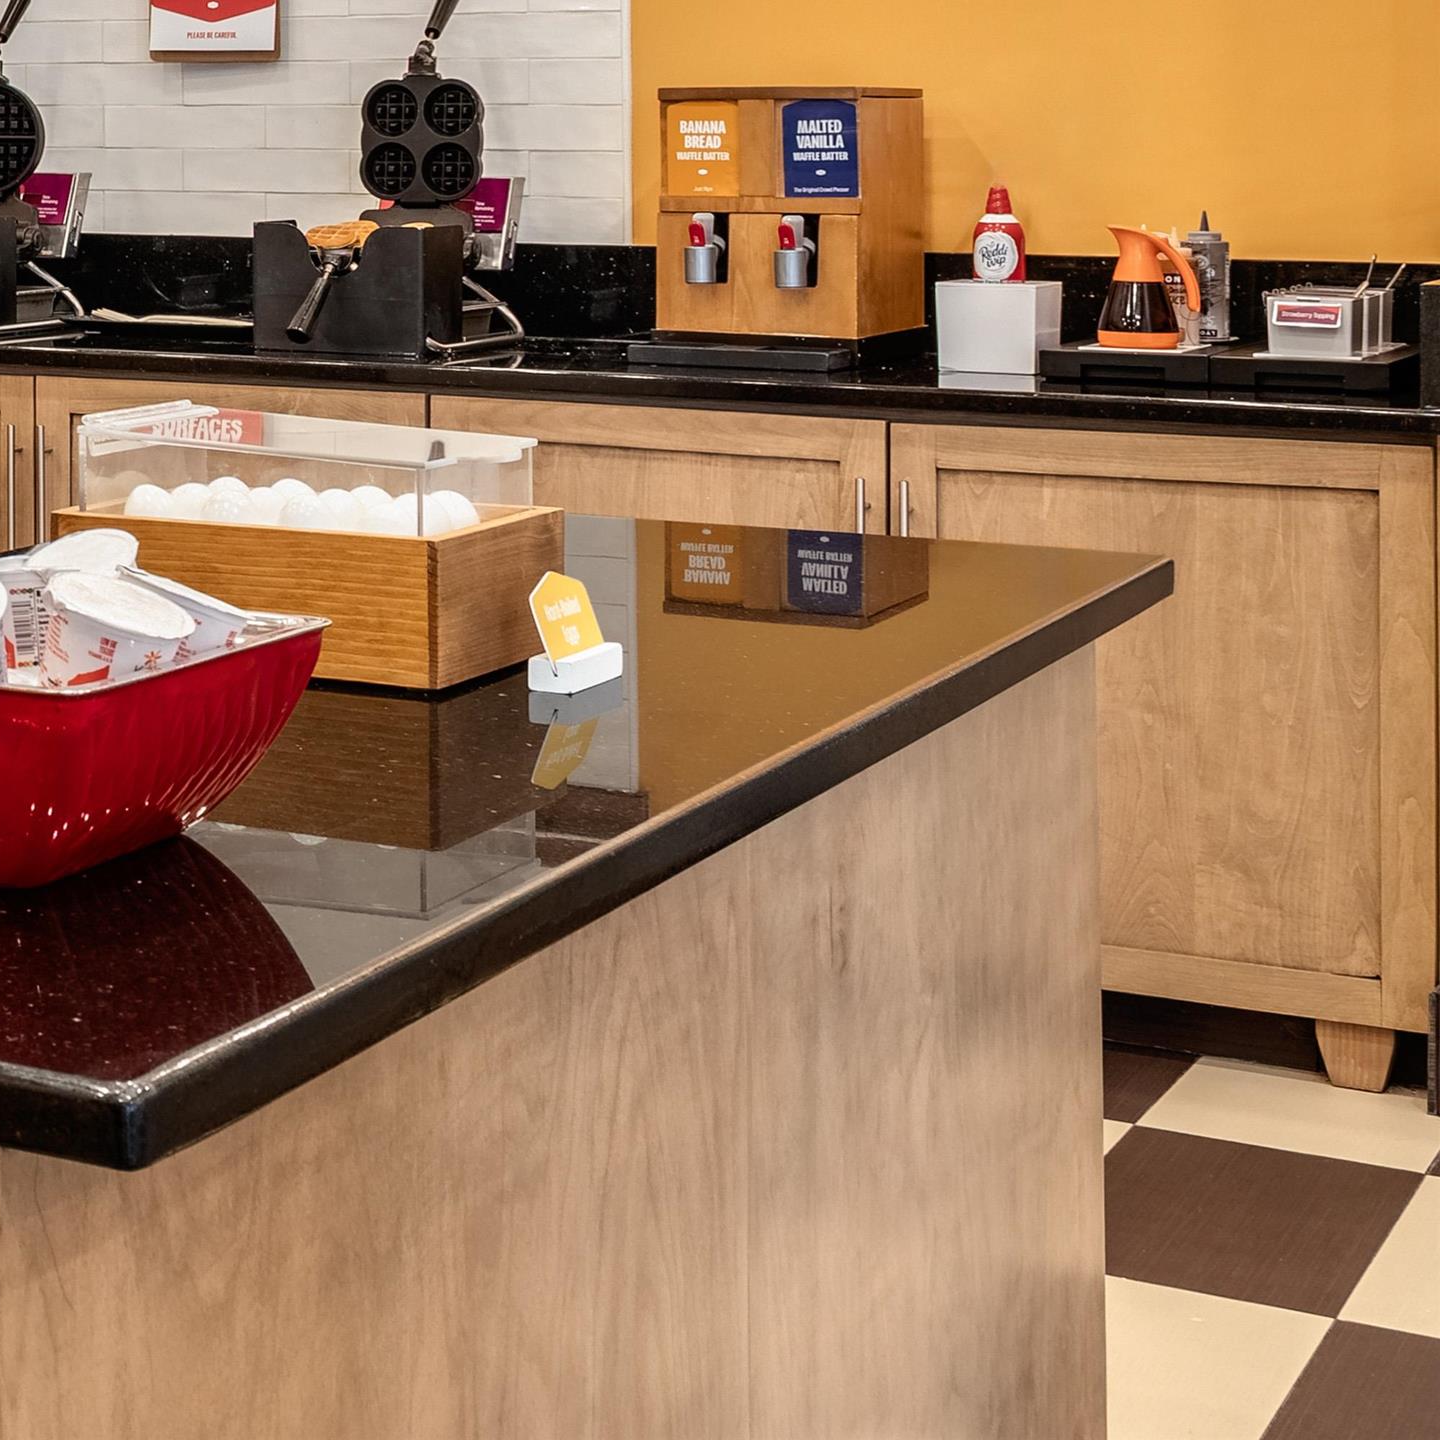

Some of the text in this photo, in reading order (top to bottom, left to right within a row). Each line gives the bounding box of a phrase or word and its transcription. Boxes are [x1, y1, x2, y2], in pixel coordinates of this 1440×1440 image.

[679, 119, 727, 135] BANANA
[796, 118, 843, 134] MALTED
[683, 134, 722, 149] BREAD
[795, 134, 845, 149] VANILLA
[676, 151, 730, 161] WAFFLE BATTER
[792, 150, 849, 161] WAFFLE BATTER
